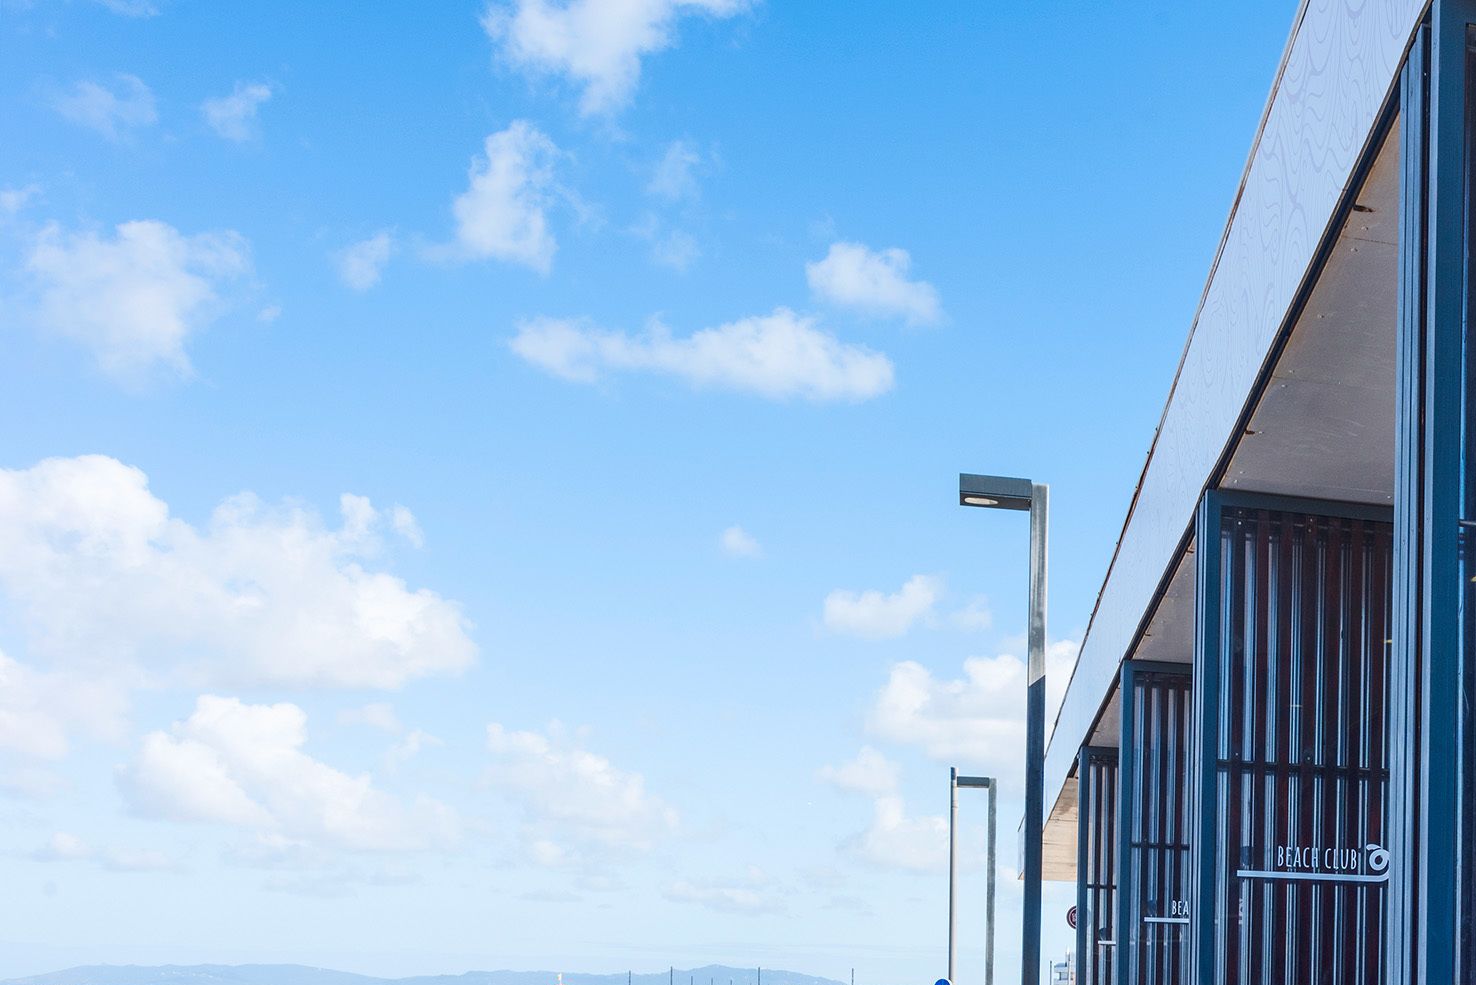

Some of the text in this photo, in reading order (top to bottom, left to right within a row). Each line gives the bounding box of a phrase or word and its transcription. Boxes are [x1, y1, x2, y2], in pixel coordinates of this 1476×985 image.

[1277, 845, 1357, 870] BEACH CLUB
[1171, 900, 1189, 916] BEA
